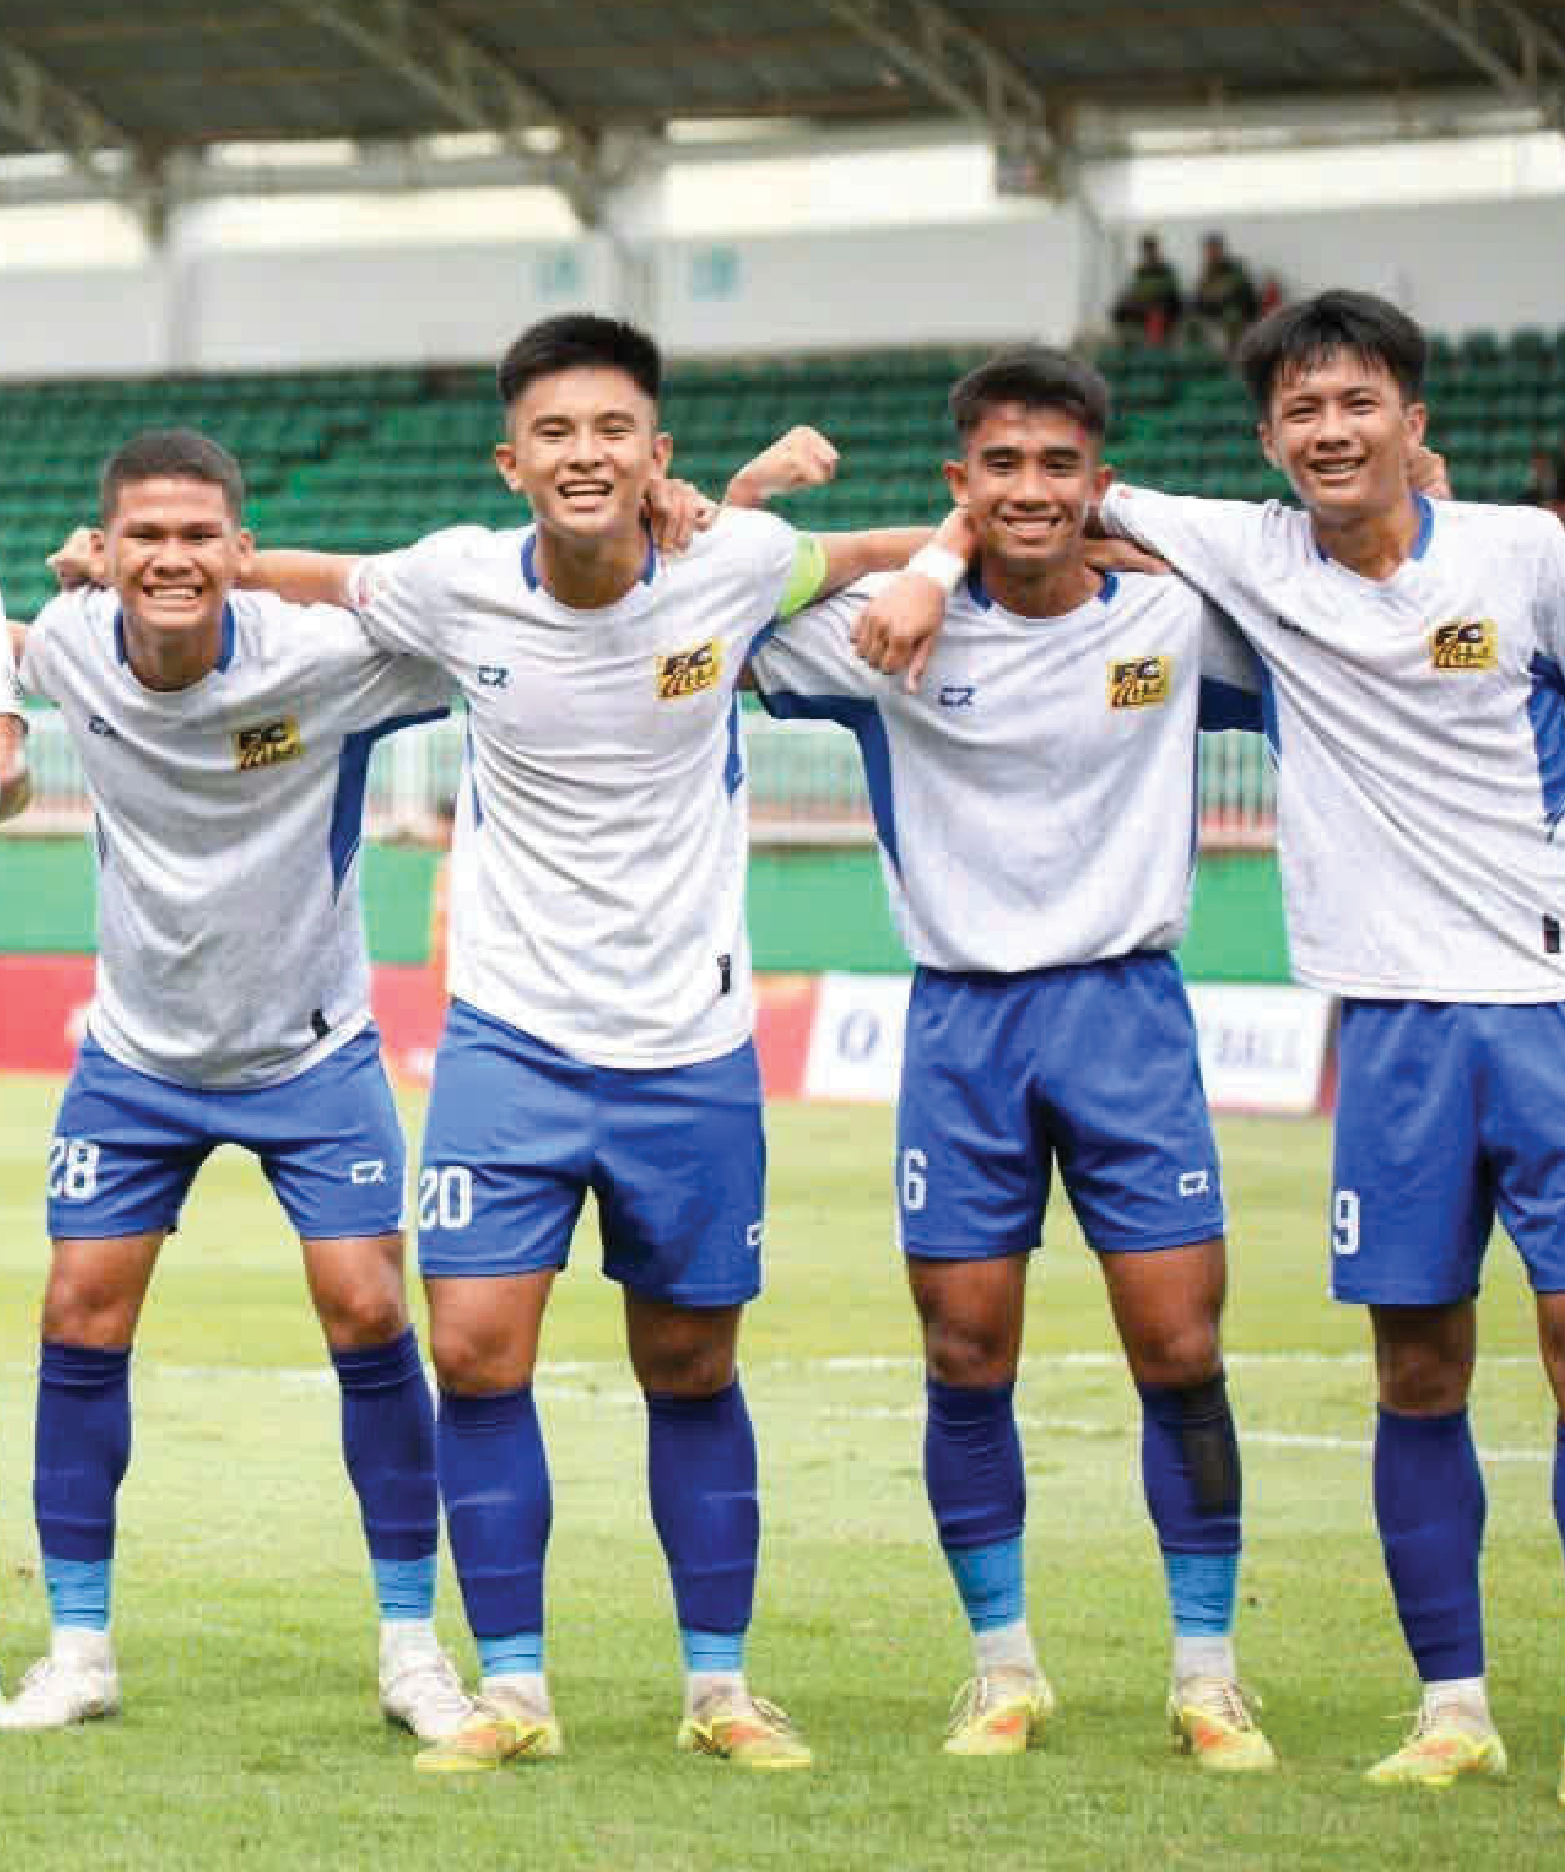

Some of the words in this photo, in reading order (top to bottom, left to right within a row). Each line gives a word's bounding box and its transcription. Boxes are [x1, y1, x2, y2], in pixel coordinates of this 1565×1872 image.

[665, 642, 713, 675] FC
[1436, 624, 1484, 646] FC
[1114, 658, 1161, 684] FC
[239, 720, 289, 748] FC
[46, 1137, 100, 1200] 28
[903, 1148, 928, 1211] 6
[418, 1165, 473, 1230] 20
[1333, 1190, 1361, 1256] 9
